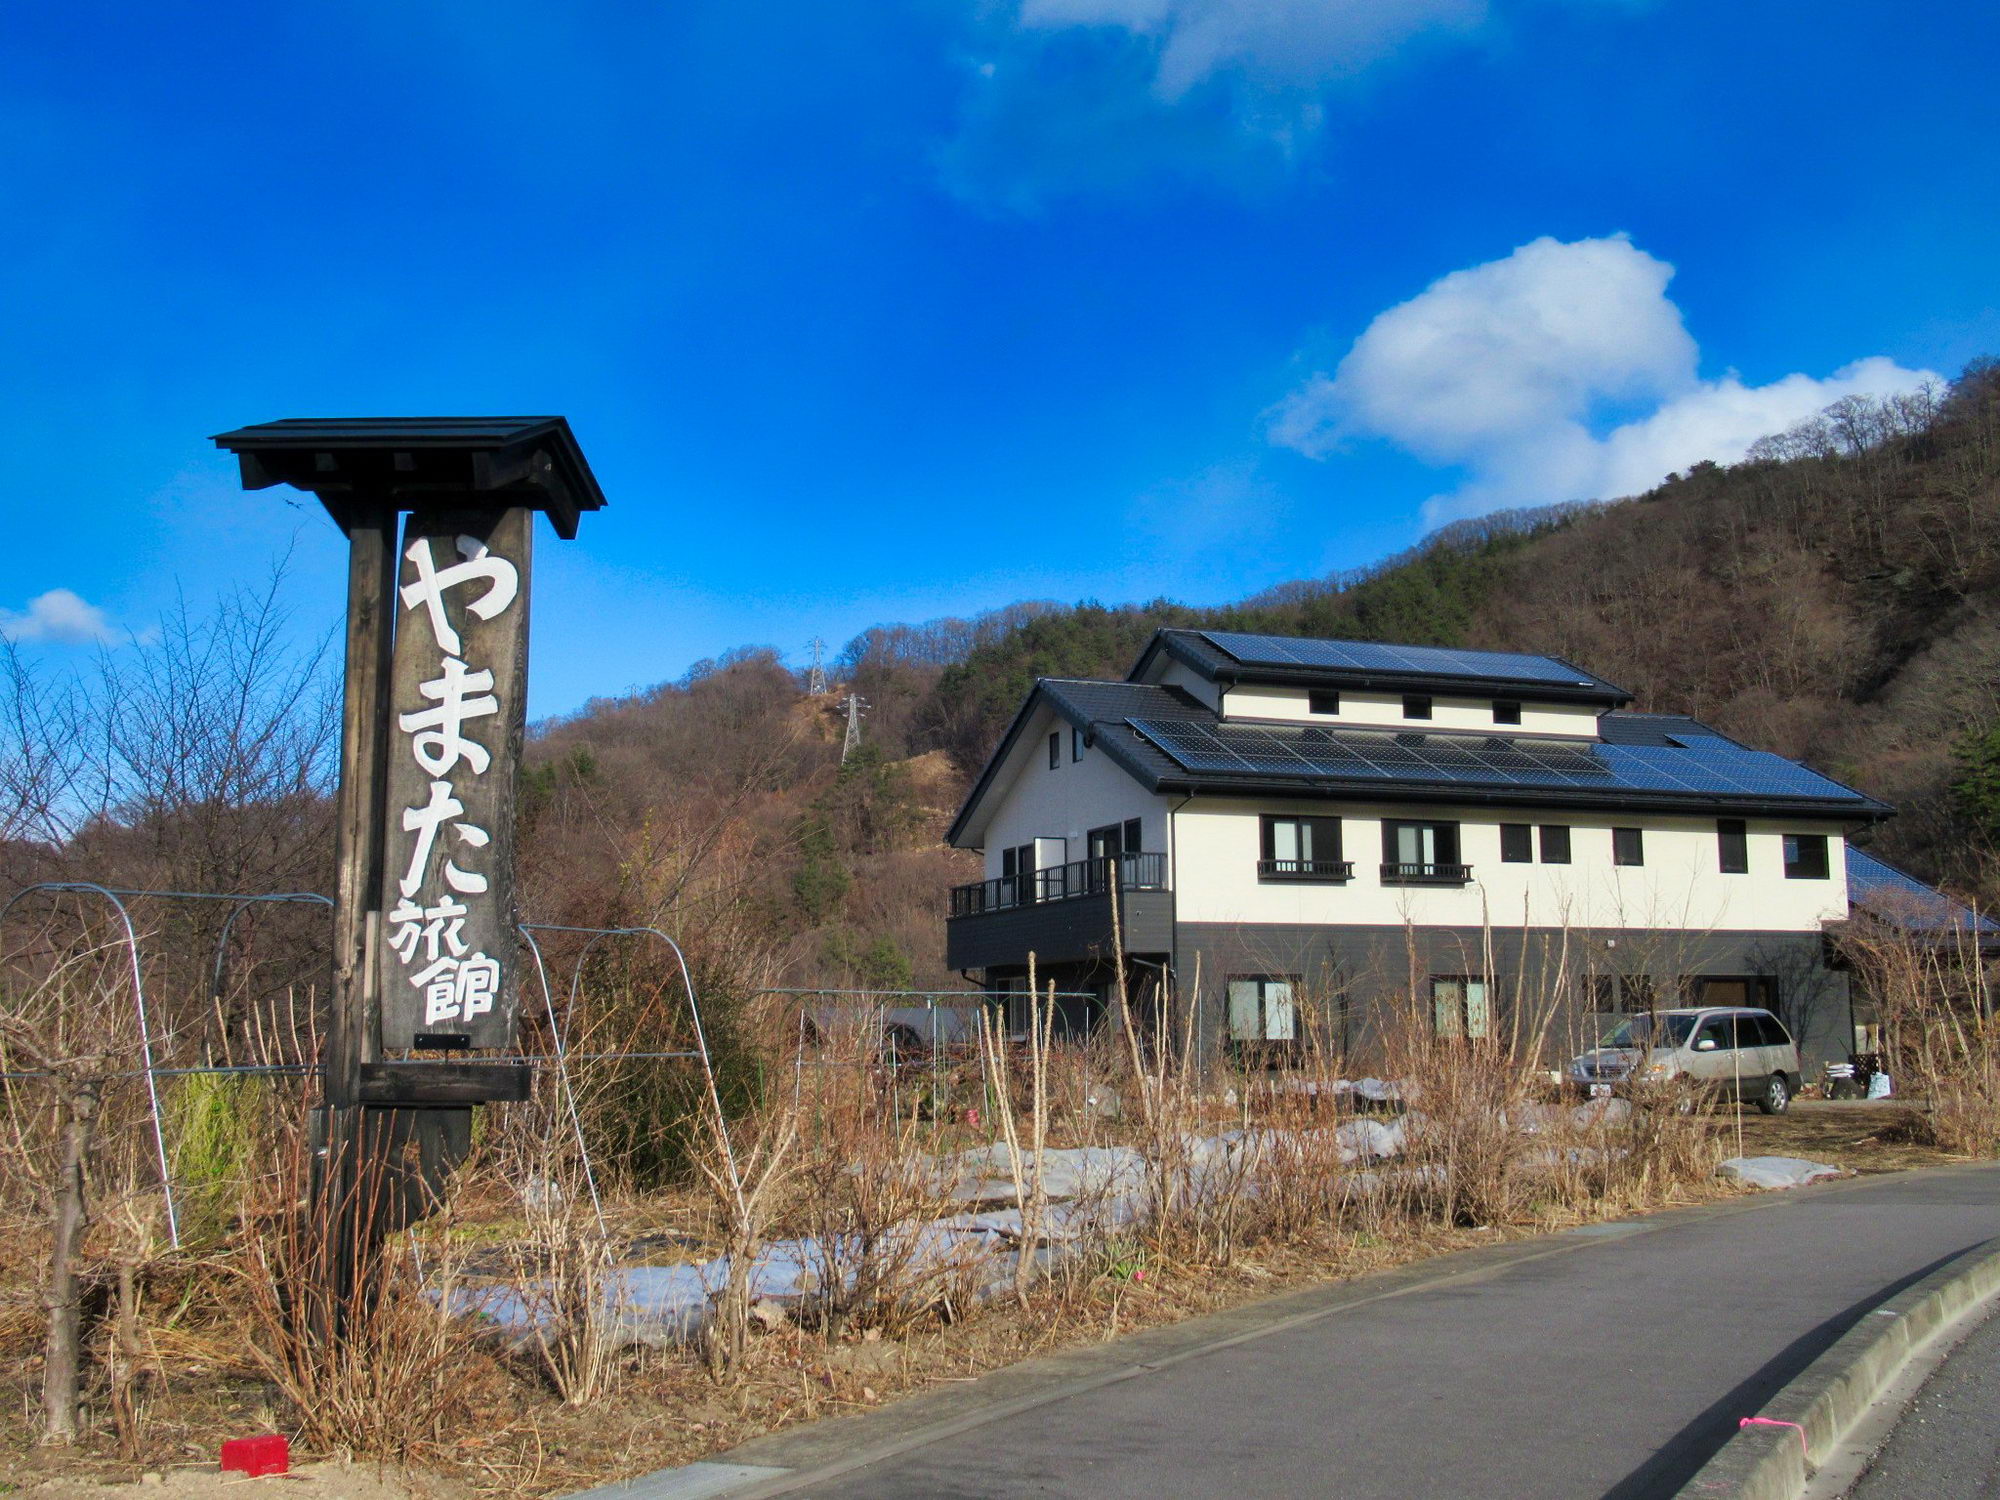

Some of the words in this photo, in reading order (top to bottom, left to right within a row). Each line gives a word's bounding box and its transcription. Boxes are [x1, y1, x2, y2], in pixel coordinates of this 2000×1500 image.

[389, 535, 518, 1025] やまた旅館
